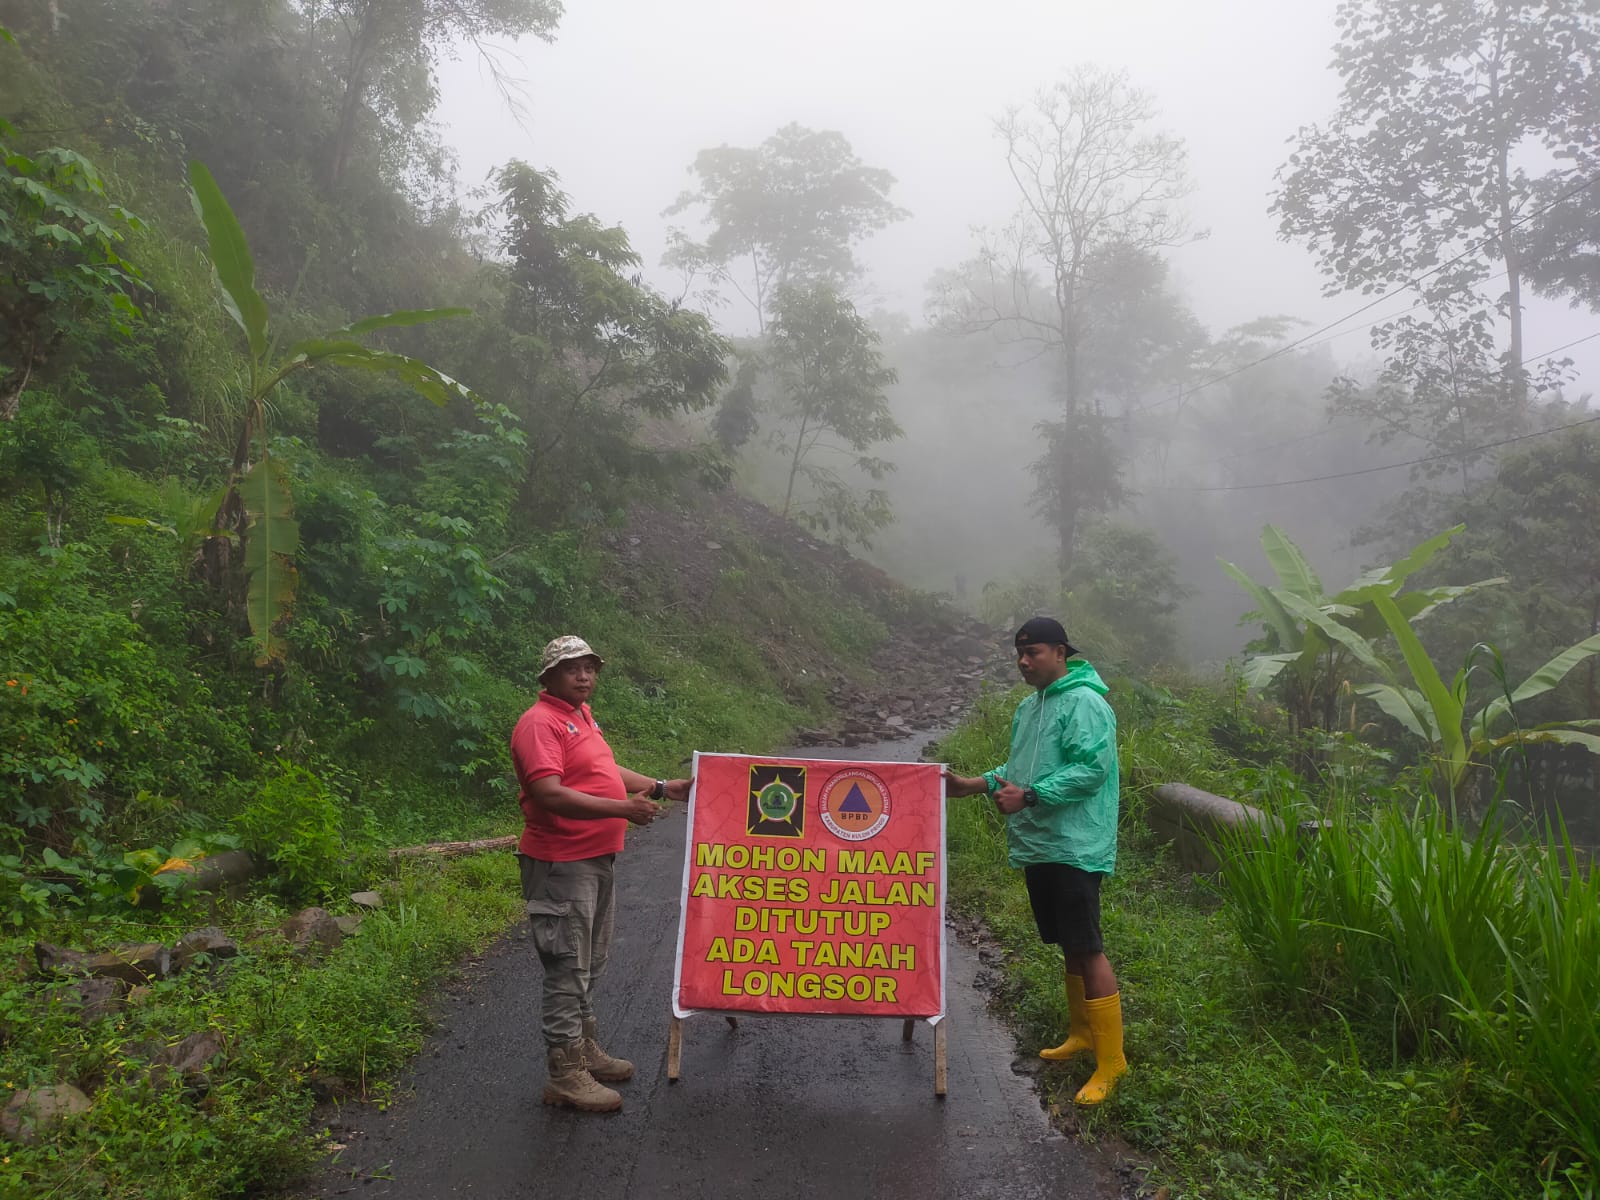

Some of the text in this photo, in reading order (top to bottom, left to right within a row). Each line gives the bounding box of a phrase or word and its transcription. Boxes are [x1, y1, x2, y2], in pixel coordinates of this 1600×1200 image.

[696, 843, 936, 875] MOHON MAAF
[691, 873, 936, 907] AKSES JALAN
[735, 907, 891, 936] DITUTUP
[705, 937, 915, 970] ADA TANAH
[722, 970, 898, 1003] LONGSOR
